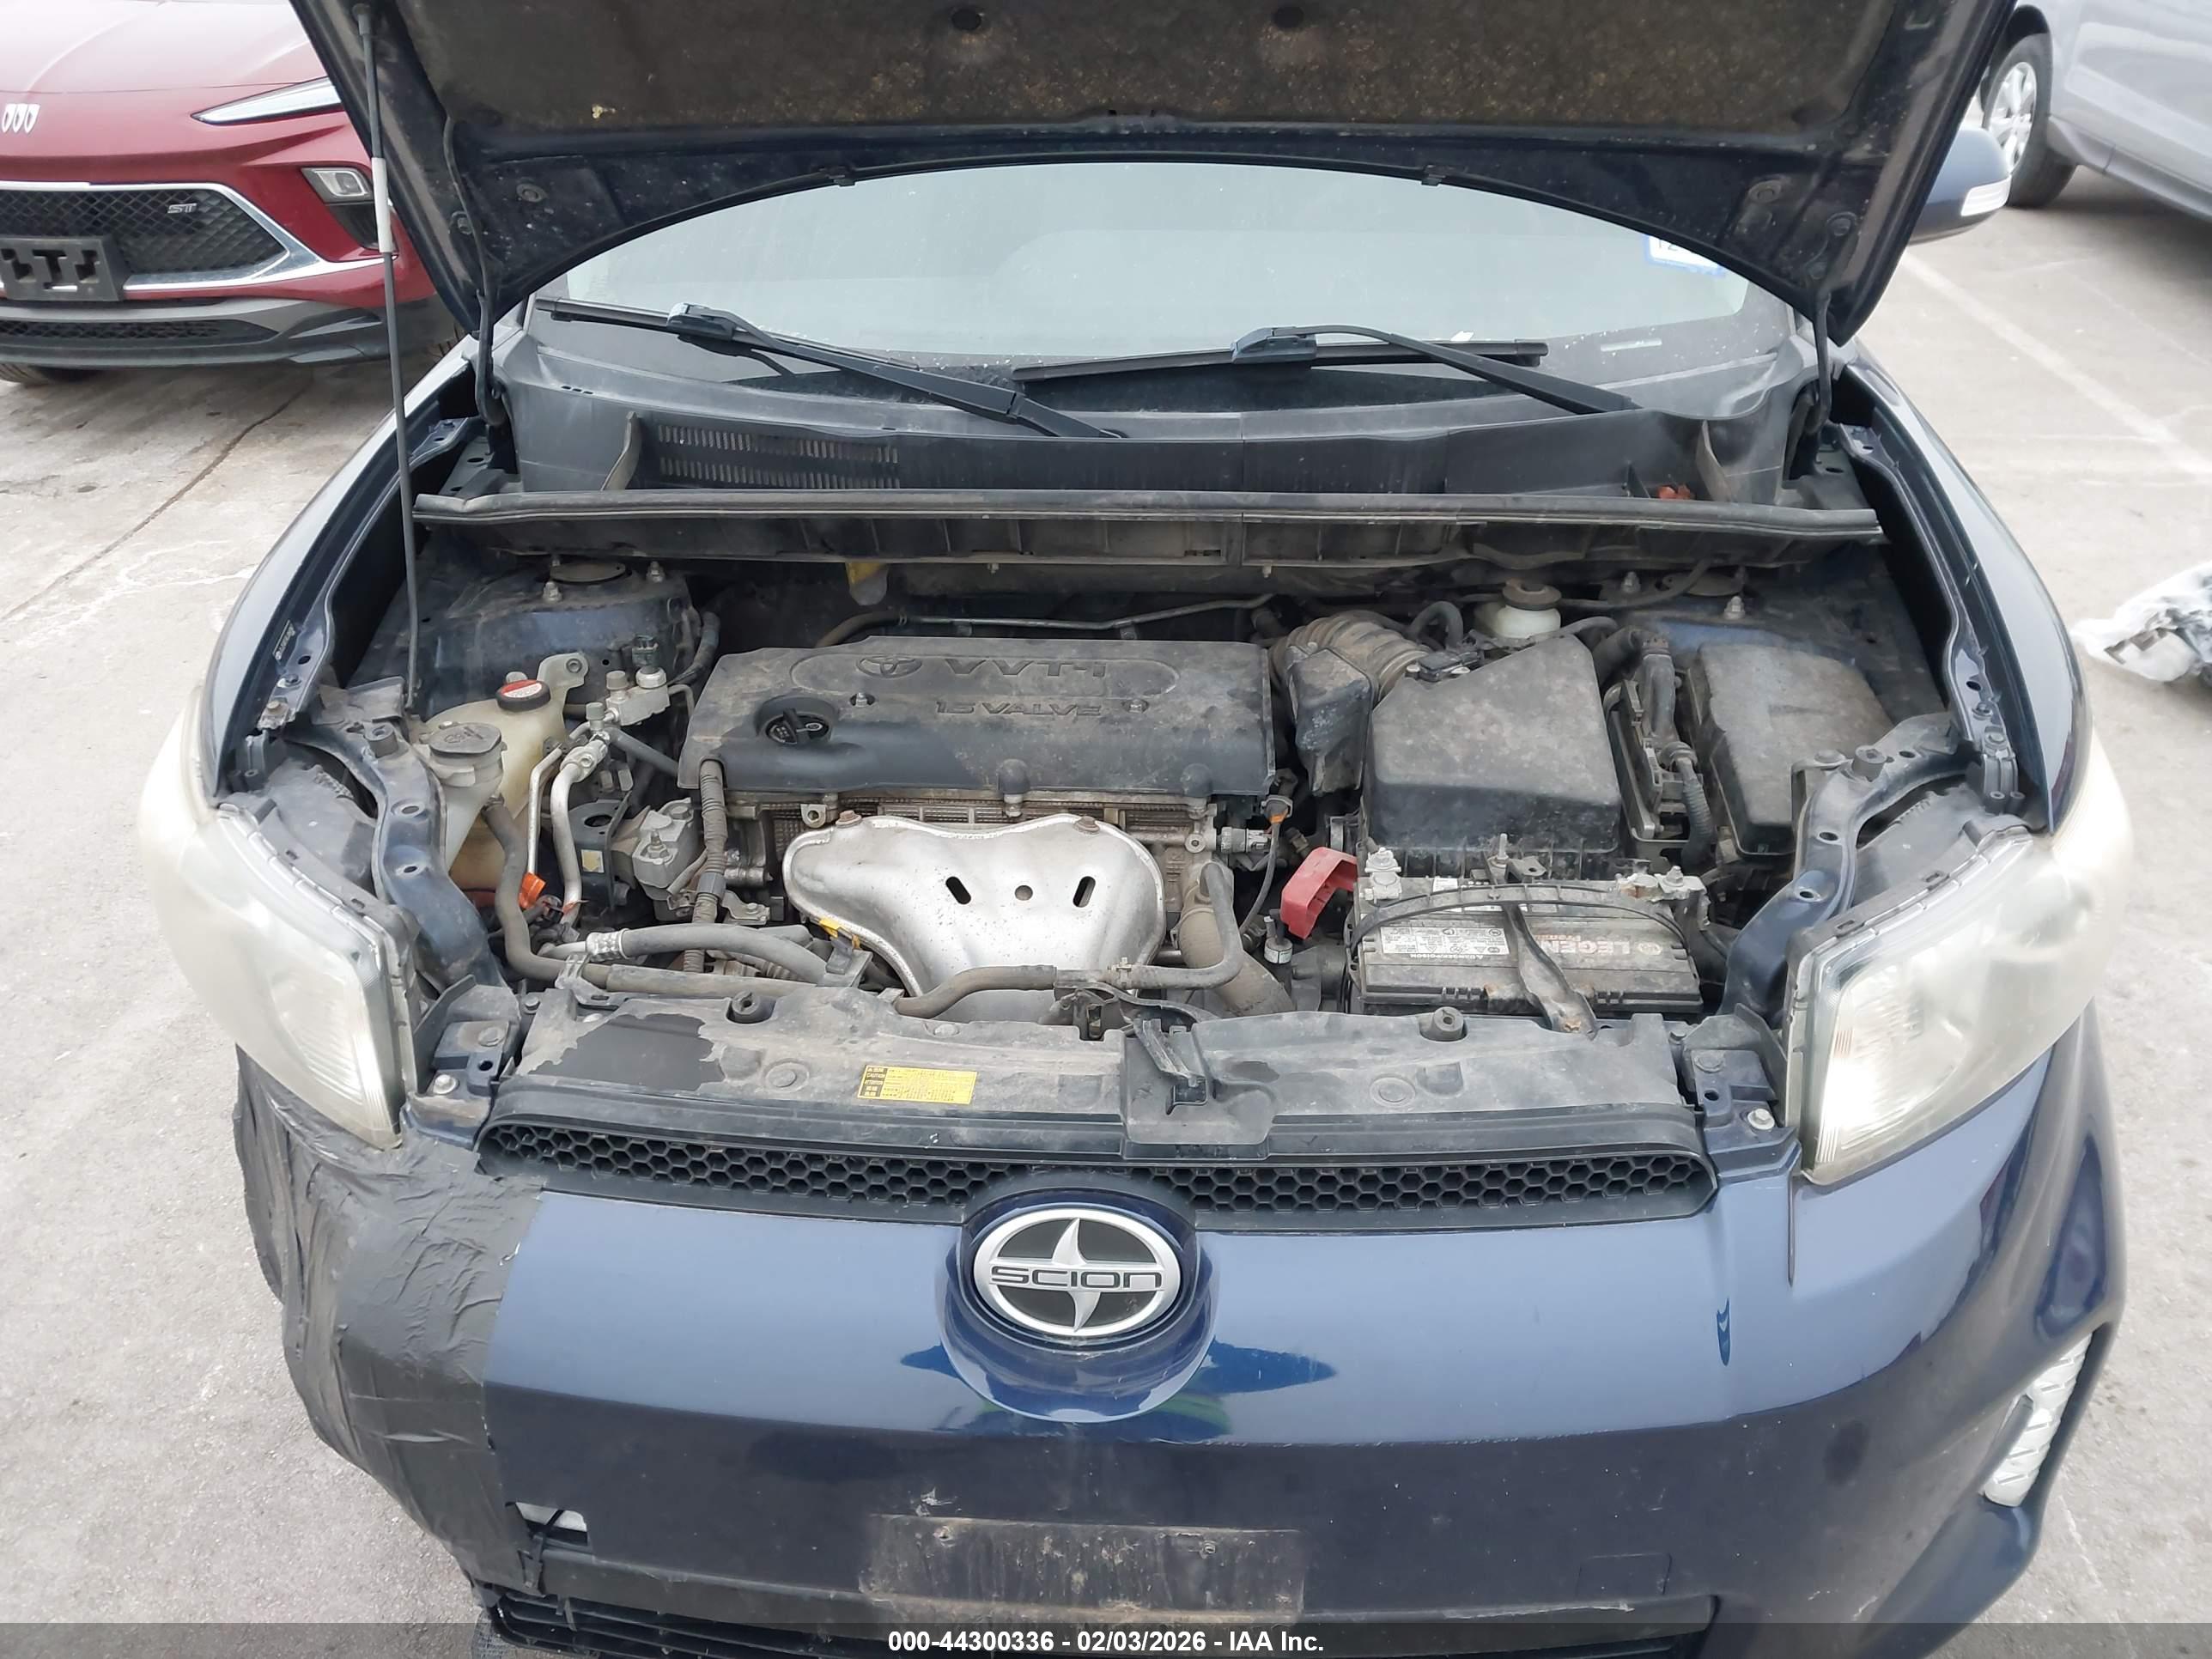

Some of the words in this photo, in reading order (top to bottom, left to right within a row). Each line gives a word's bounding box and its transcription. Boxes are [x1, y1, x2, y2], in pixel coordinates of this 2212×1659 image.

[167, 203, 197, 214] ST
[982, 702, 1102, 716] VALVE
[1540, 940, 1631, 955] LEGEN
